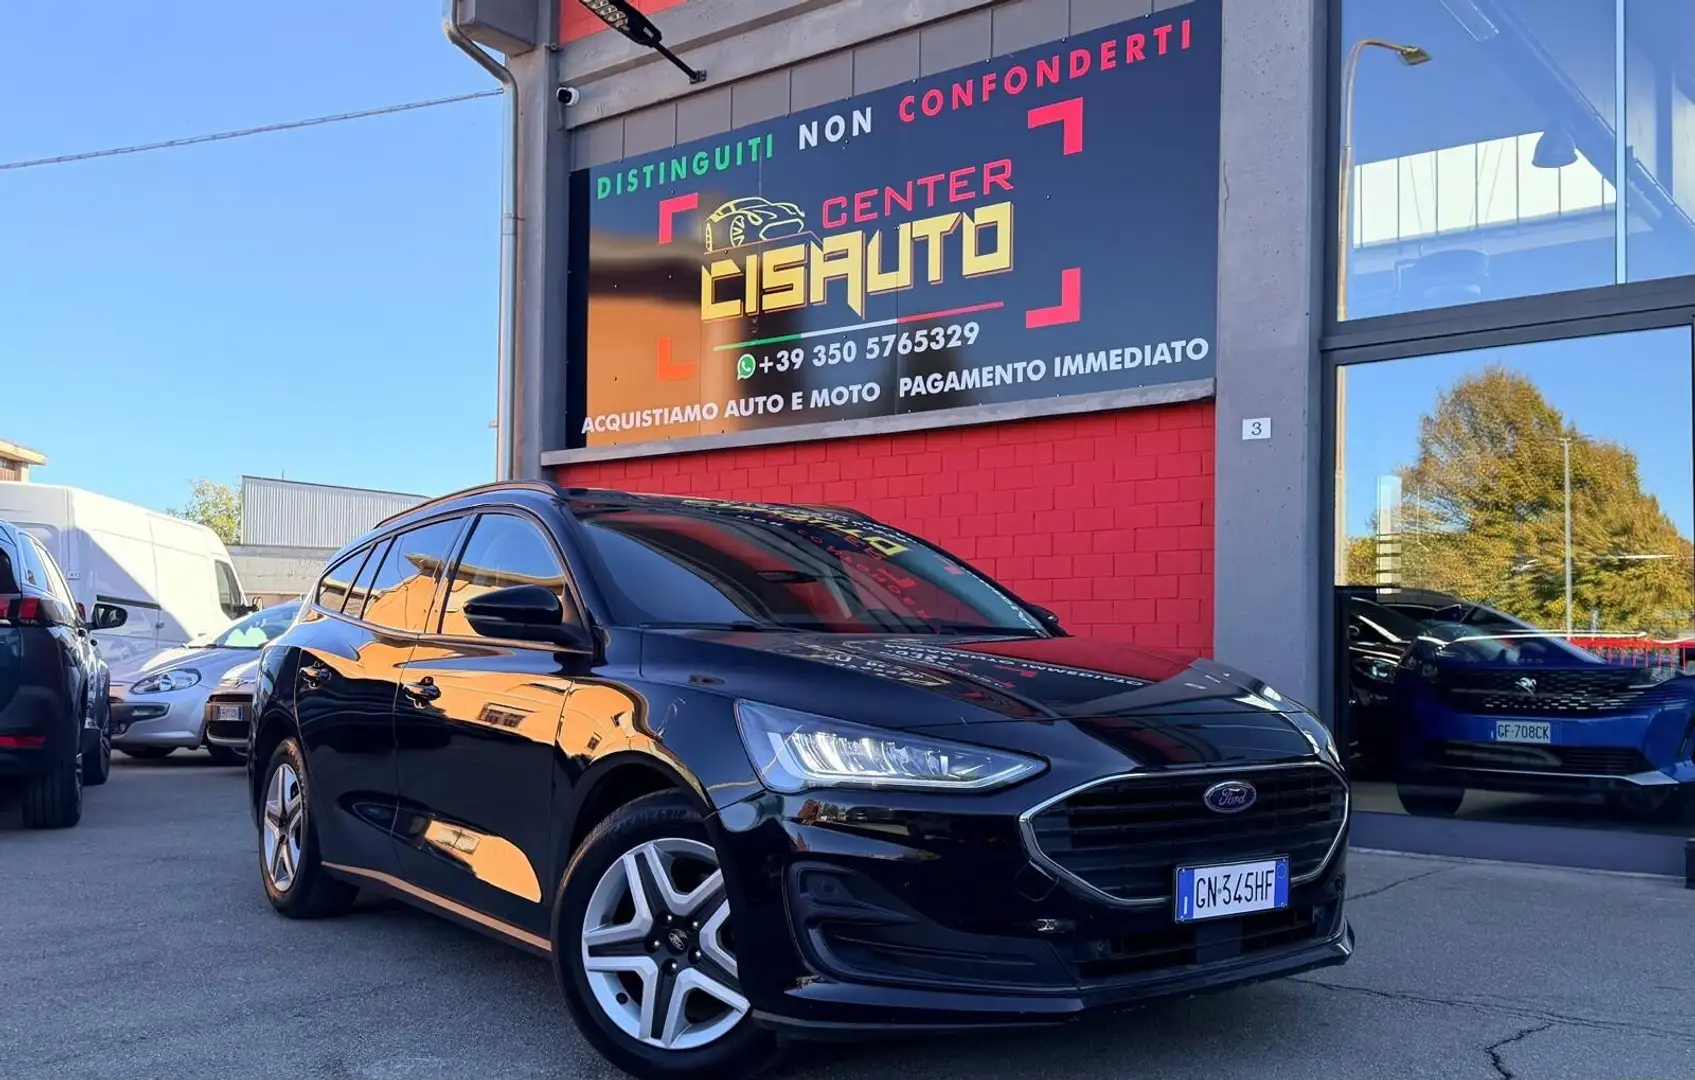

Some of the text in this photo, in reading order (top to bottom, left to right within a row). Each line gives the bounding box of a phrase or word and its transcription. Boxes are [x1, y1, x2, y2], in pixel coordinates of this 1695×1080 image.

[597, 19, 1191, 200] DISTINGUITI NON CONFONDERTI
[822, 158, 1014, 228] CENTER
[701, 201, 1014, 321] CISAUTO
[759, 321, 980, 375] +39 350 5765329
[581, 338, 1209, 434] ACQUISTIAMO AUTO E MOTO PAGAMENTO IMMEDIATO
[1251, 421, 1262, 436] 3
[1218, 786, 1248, 806] Ford
[1195, 869, 1275, 909] GN345HF
